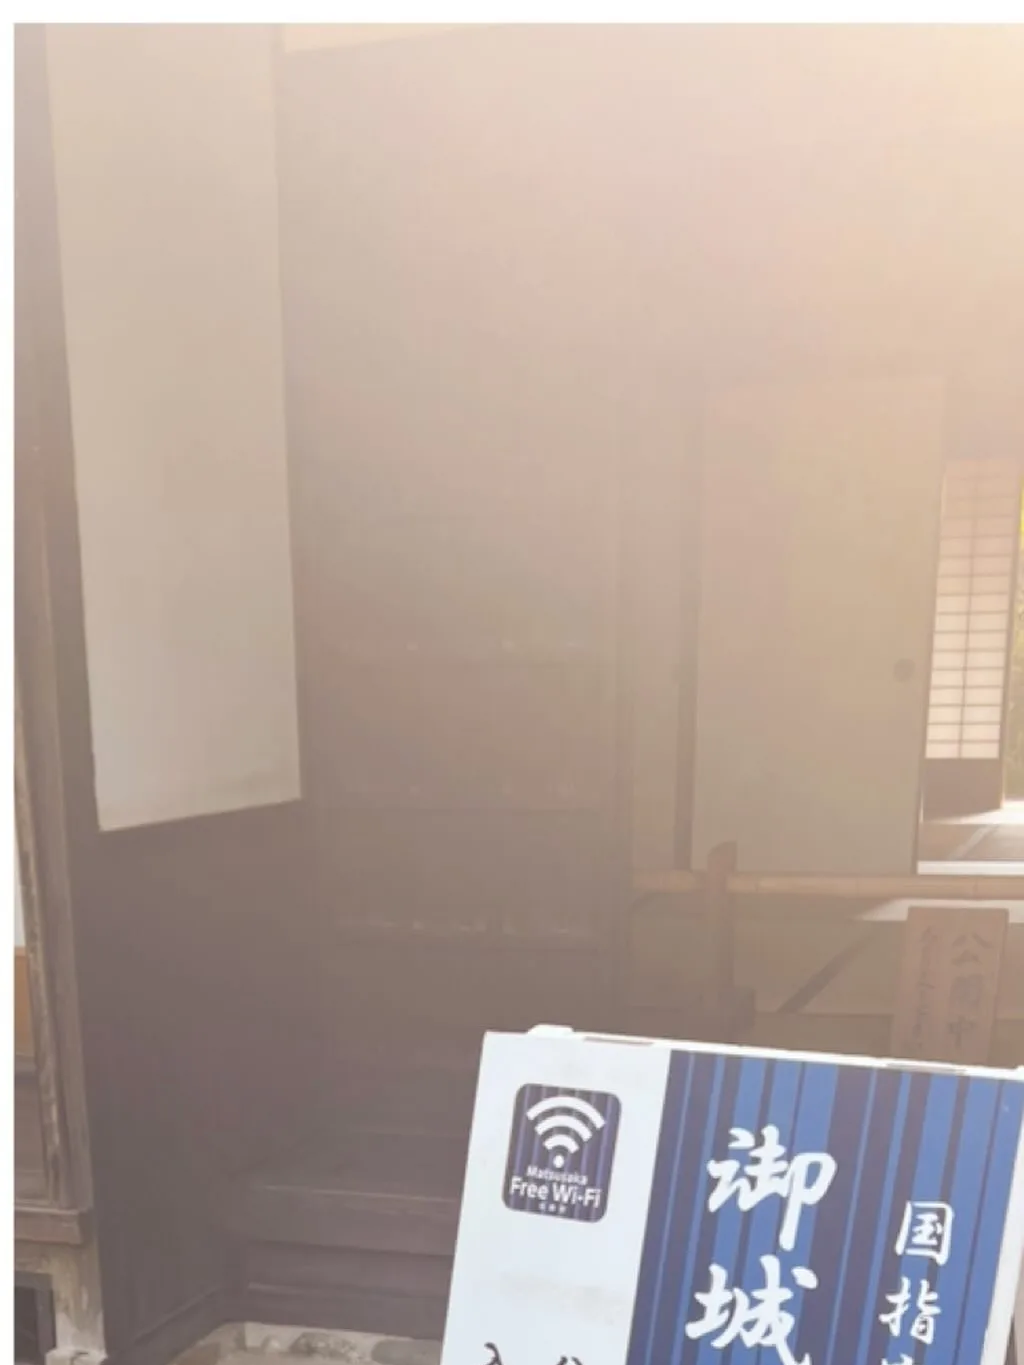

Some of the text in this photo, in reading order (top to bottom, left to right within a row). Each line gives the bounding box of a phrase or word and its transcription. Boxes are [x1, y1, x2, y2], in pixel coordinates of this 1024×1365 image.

[526, 1165, 588, 1185] Matsusaka
[509, 1176, 550, 1200] Free
[551, 1182, 602, 1209] Wi-Fi
